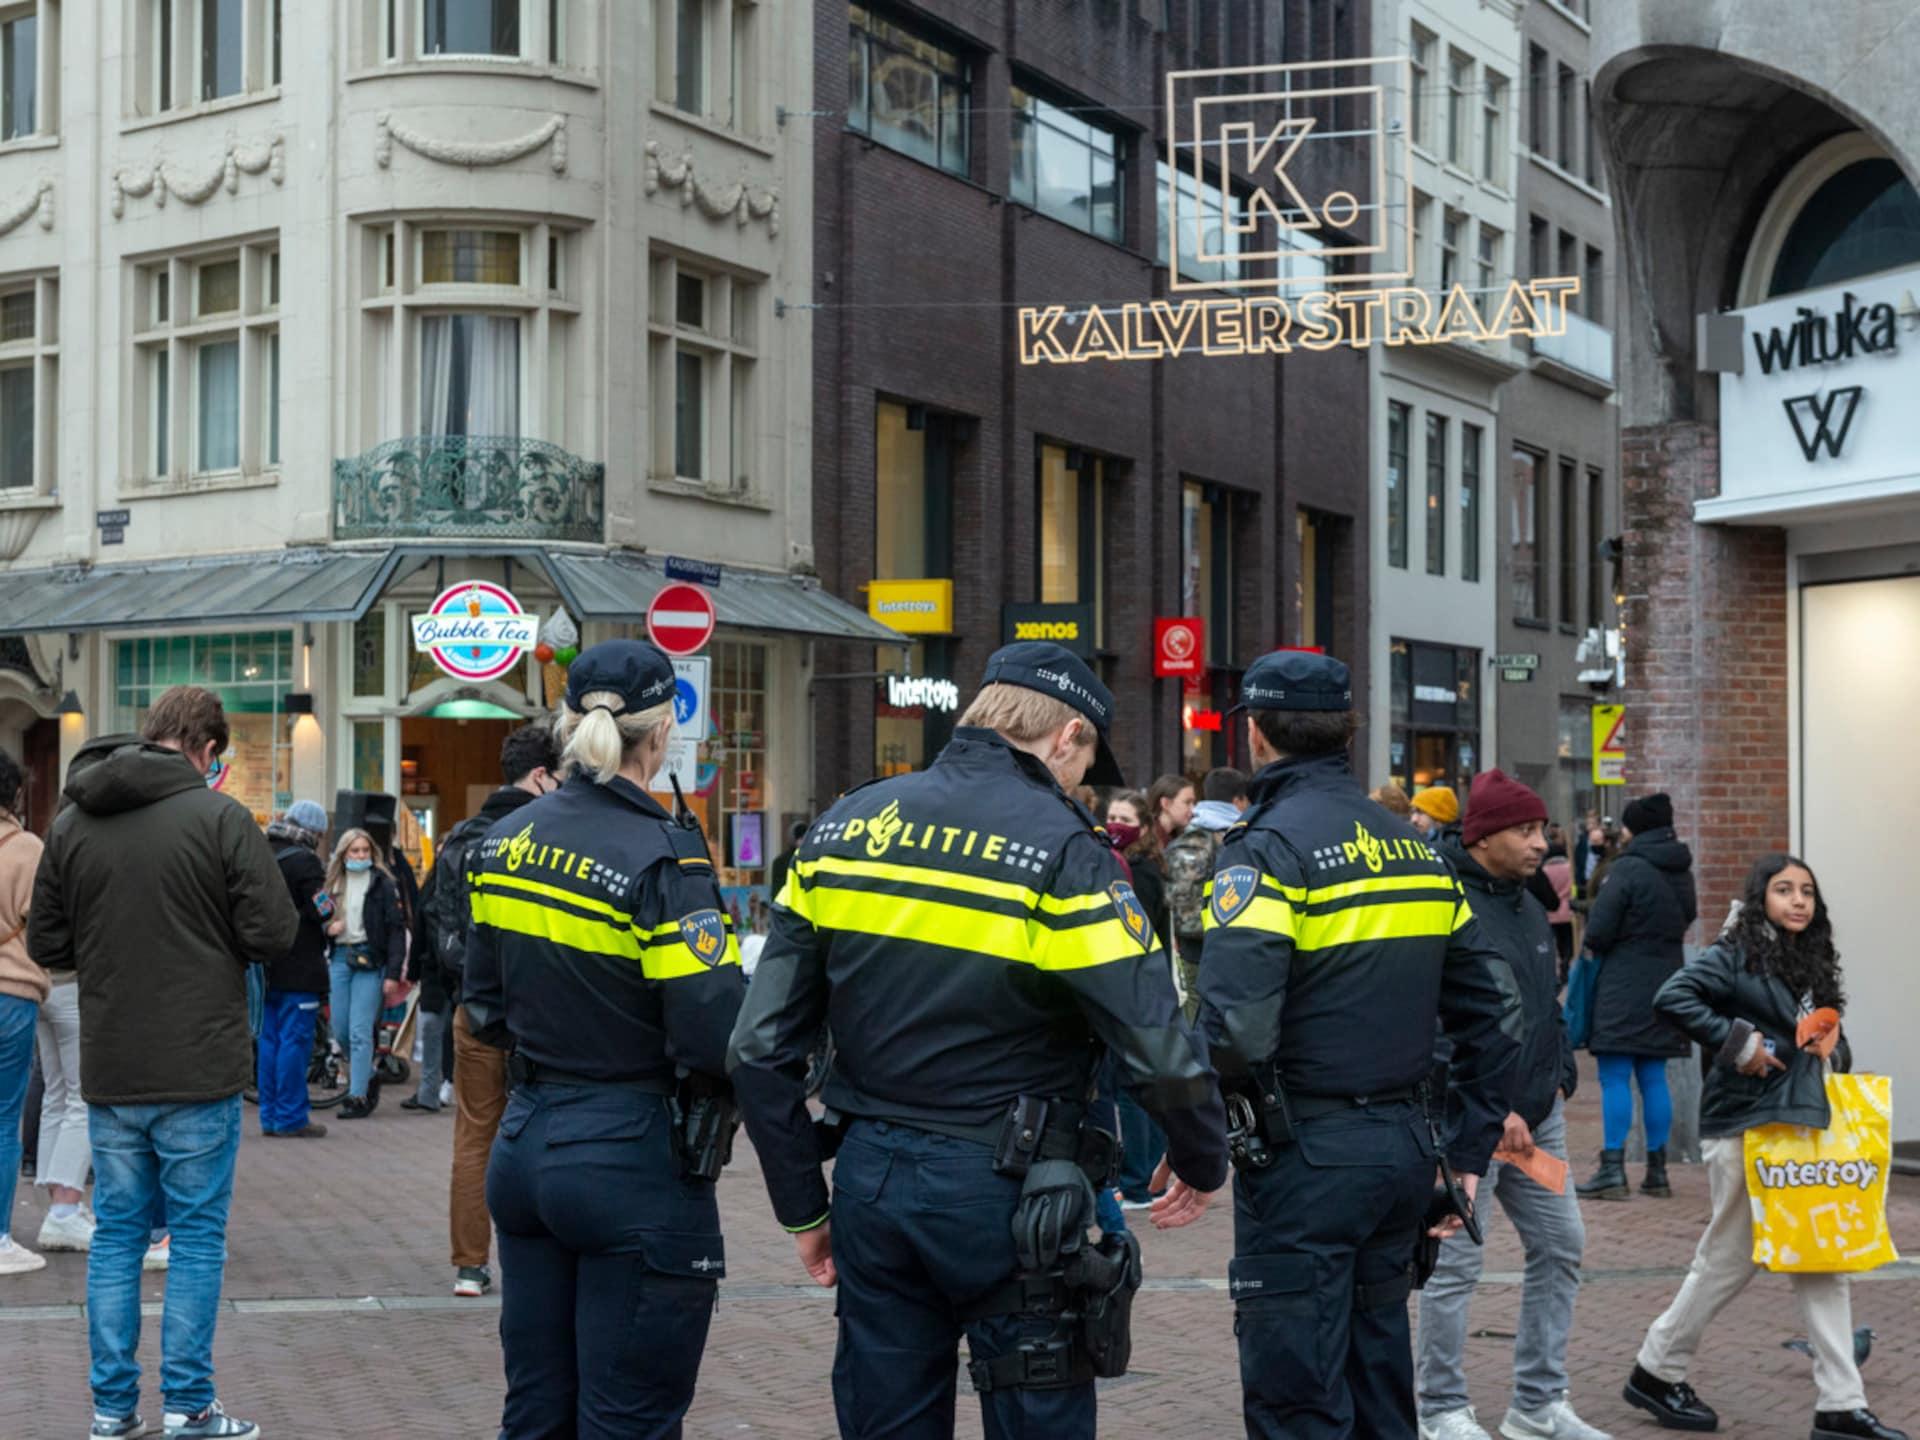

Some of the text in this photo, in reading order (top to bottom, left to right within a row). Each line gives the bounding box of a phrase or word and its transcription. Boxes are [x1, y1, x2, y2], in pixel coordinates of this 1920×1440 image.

[1018, 276, 1580, 364] KALVERSTRAAT
[1782, 385, 1863, 462] W
[878, 600, 936, 613] Intertoys
[418, 620, 530, 643] Bubble Tea
[1015, 622, 1078, 639] xenos
[674, 663, 692, 672] NE
[888, 675, 959, 712] Intertoys
[496, 822, 595, 880] POLITIE
[842, 799, 1007, 861] POLITIE
[1342, 821, 1434, 872] POLITIE
